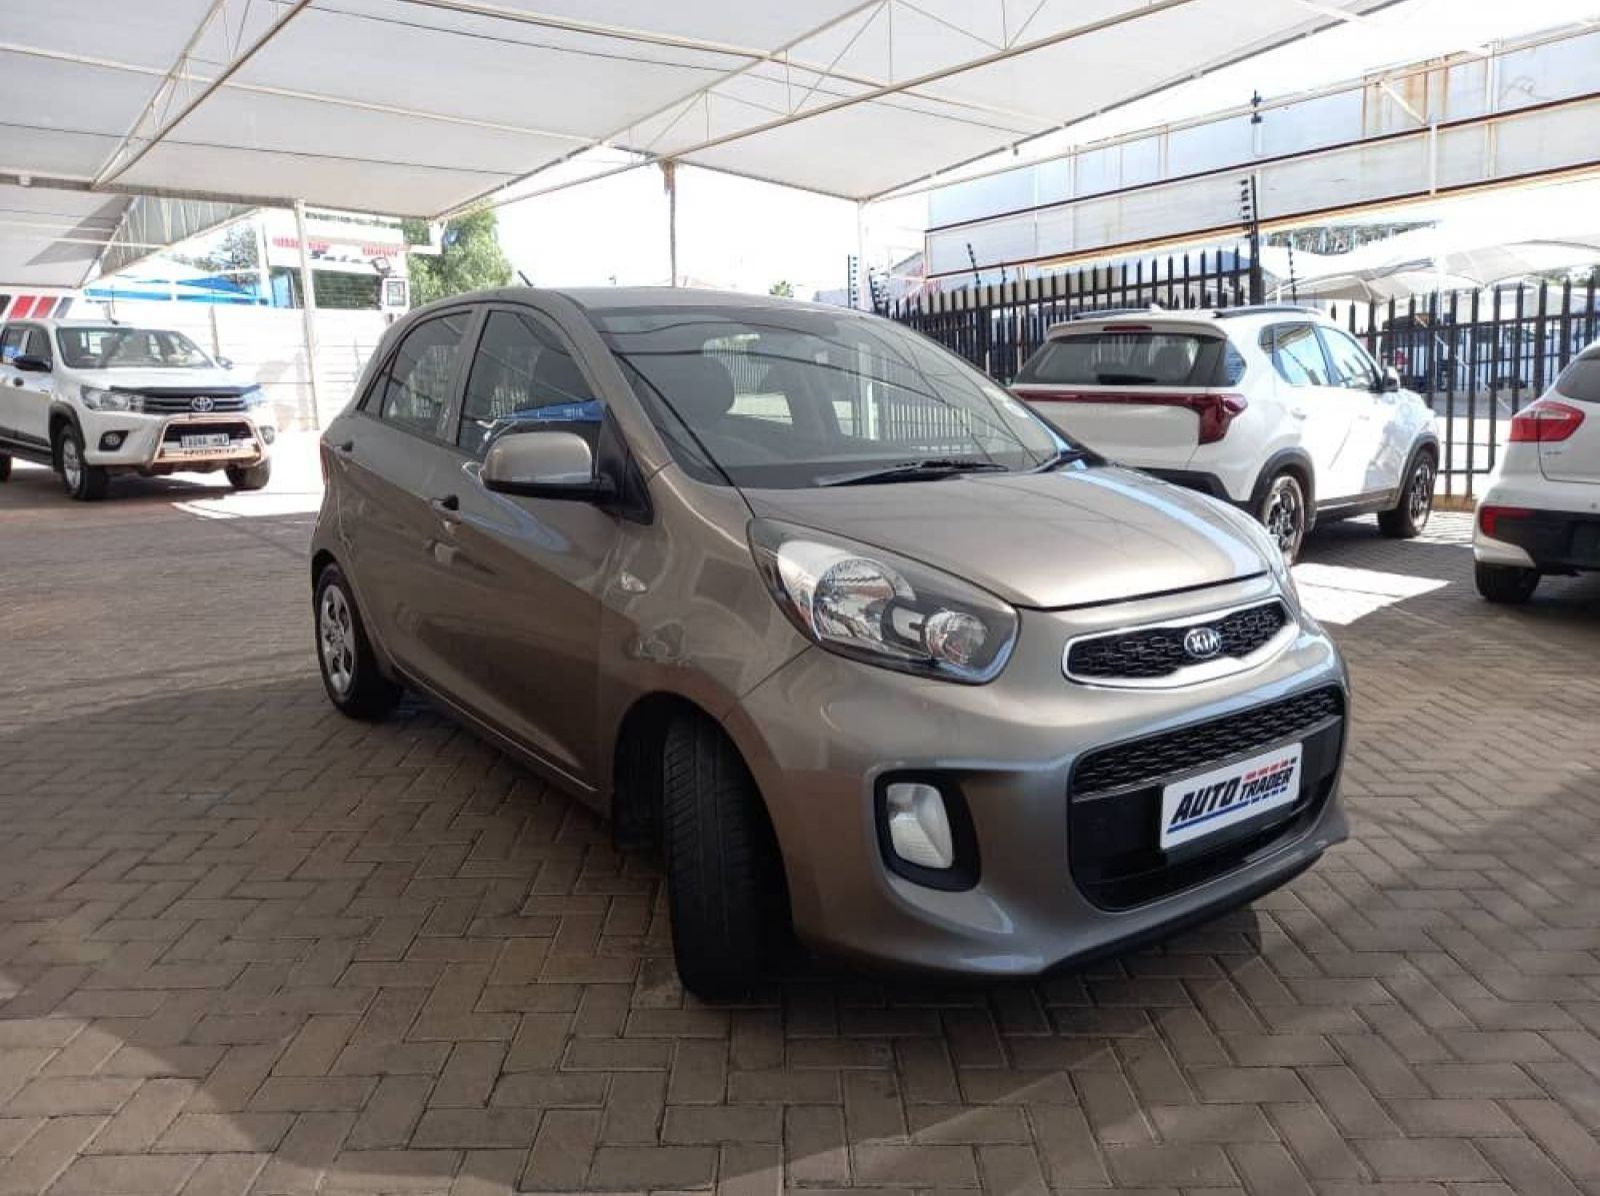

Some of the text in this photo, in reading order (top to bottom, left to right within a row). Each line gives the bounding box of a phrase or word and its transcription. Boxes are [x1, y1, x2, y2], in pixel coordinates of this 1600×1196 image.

[1187, 632, 1220, 654] KIA
[1171, 776, 1242, 825] AUTO
[1239, 766, 1294, 801] TRADER
